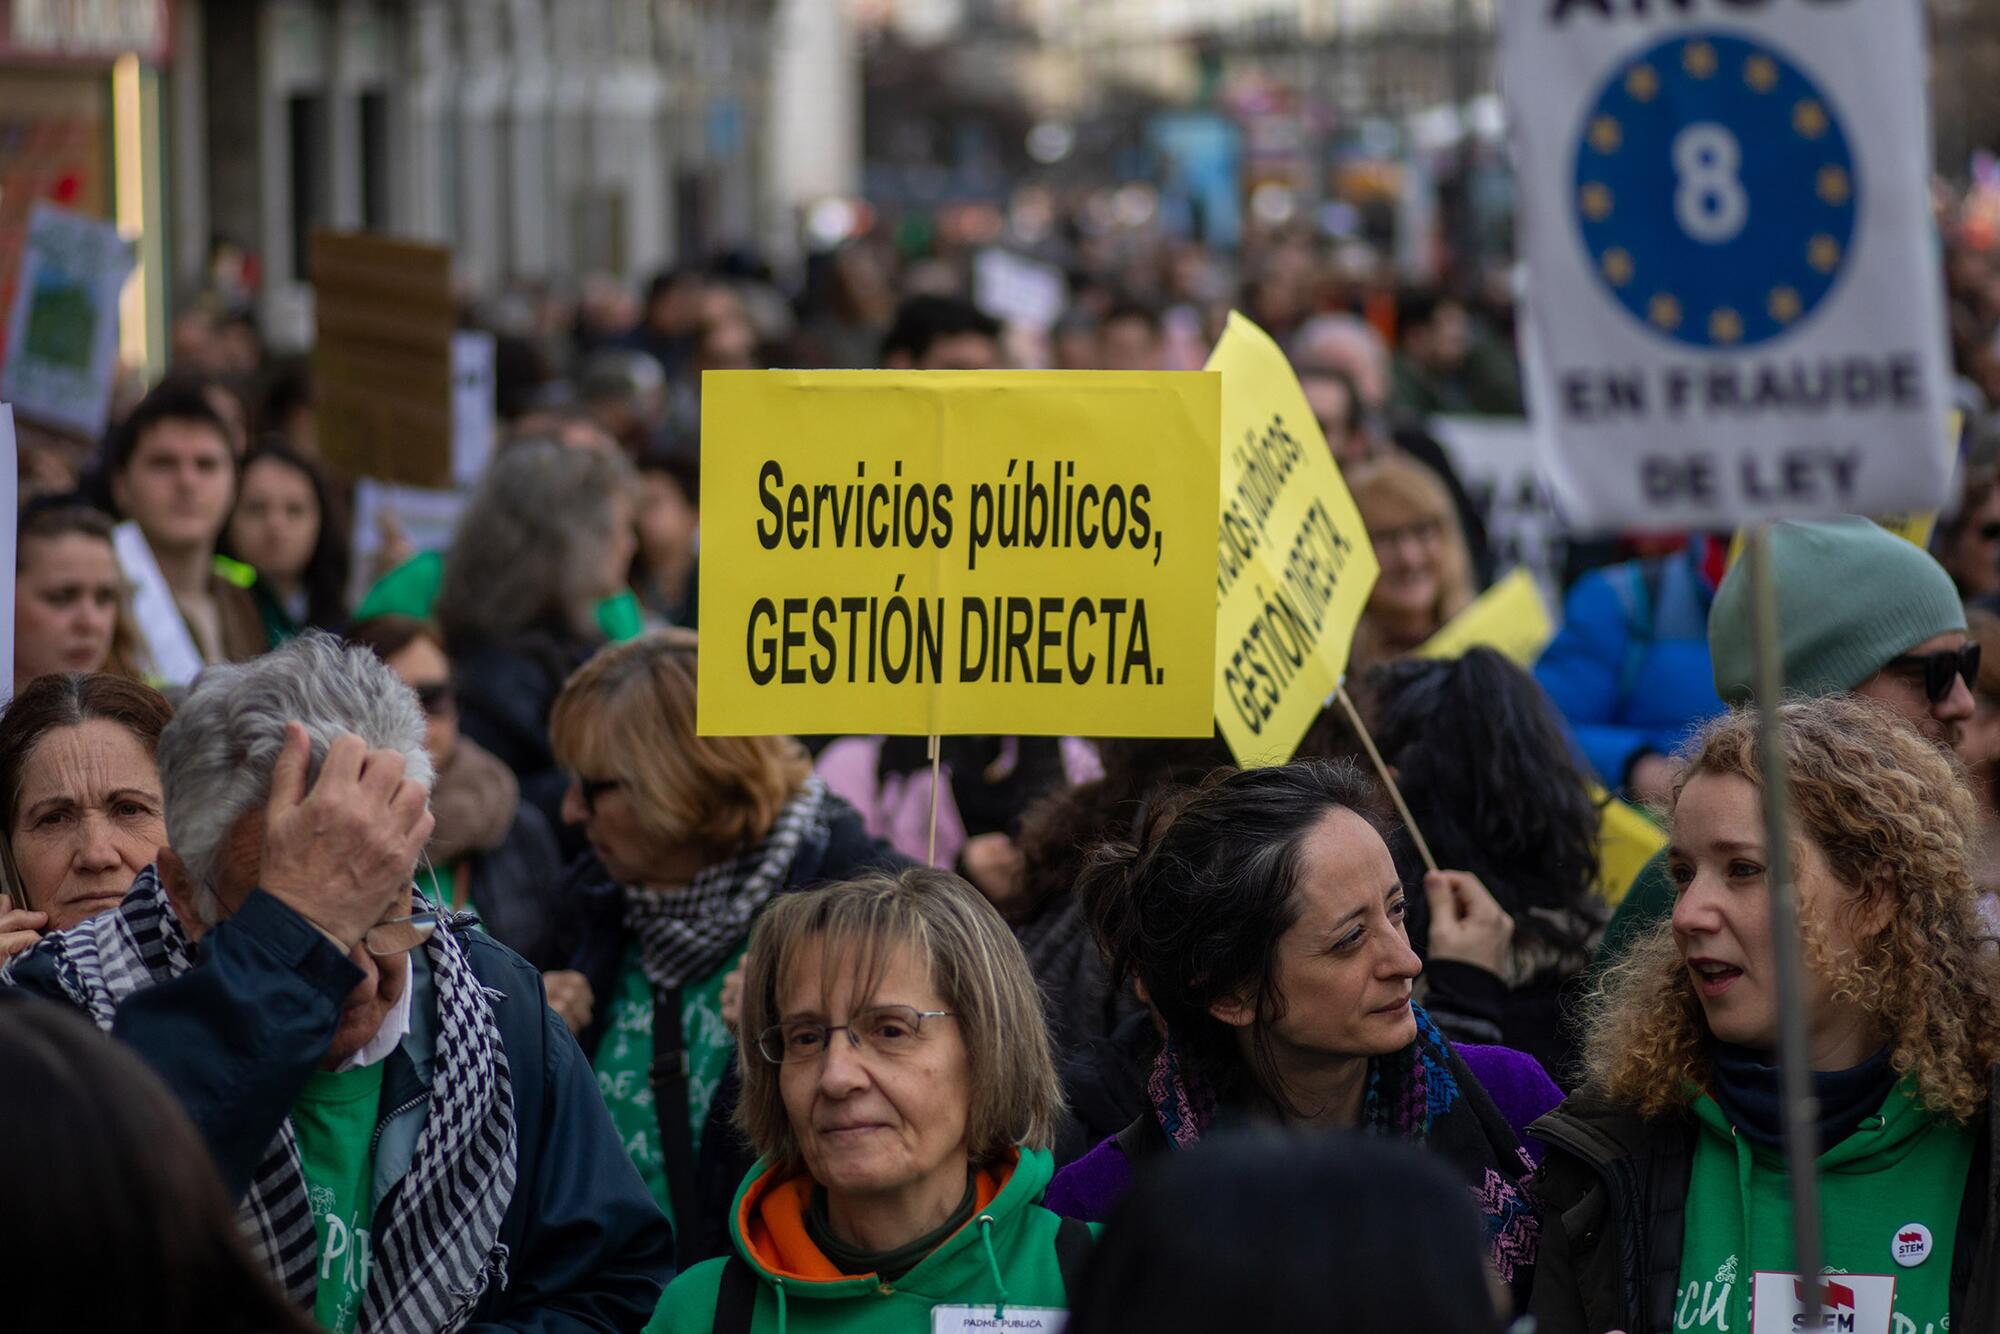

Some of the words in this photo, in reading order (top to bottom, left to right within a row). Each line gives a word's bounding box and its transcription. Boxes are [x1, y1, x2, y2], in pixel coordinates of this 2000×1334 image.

[1671, 121, 1748, 244] 8
[1560, 370, 1643, 422] EN
[1664, 356, 1922, 416] FRAUDE
[756, 459, 954, 550] Servicios
[968, 458, 1163, 570] públicos,
[1642, 452, 1716, 503] DE
[1741, 449, 1858, 501] LEY
[746, 573, 945, 687] GESTIÓN
[959, 596, 1165, 686] DIRECTA.
[1224, 584, 1317, 736] GESTIÓN
[1898, 1243, 1924, 1254] STEM
[1792, 1312, 1855, 1333] SEM
